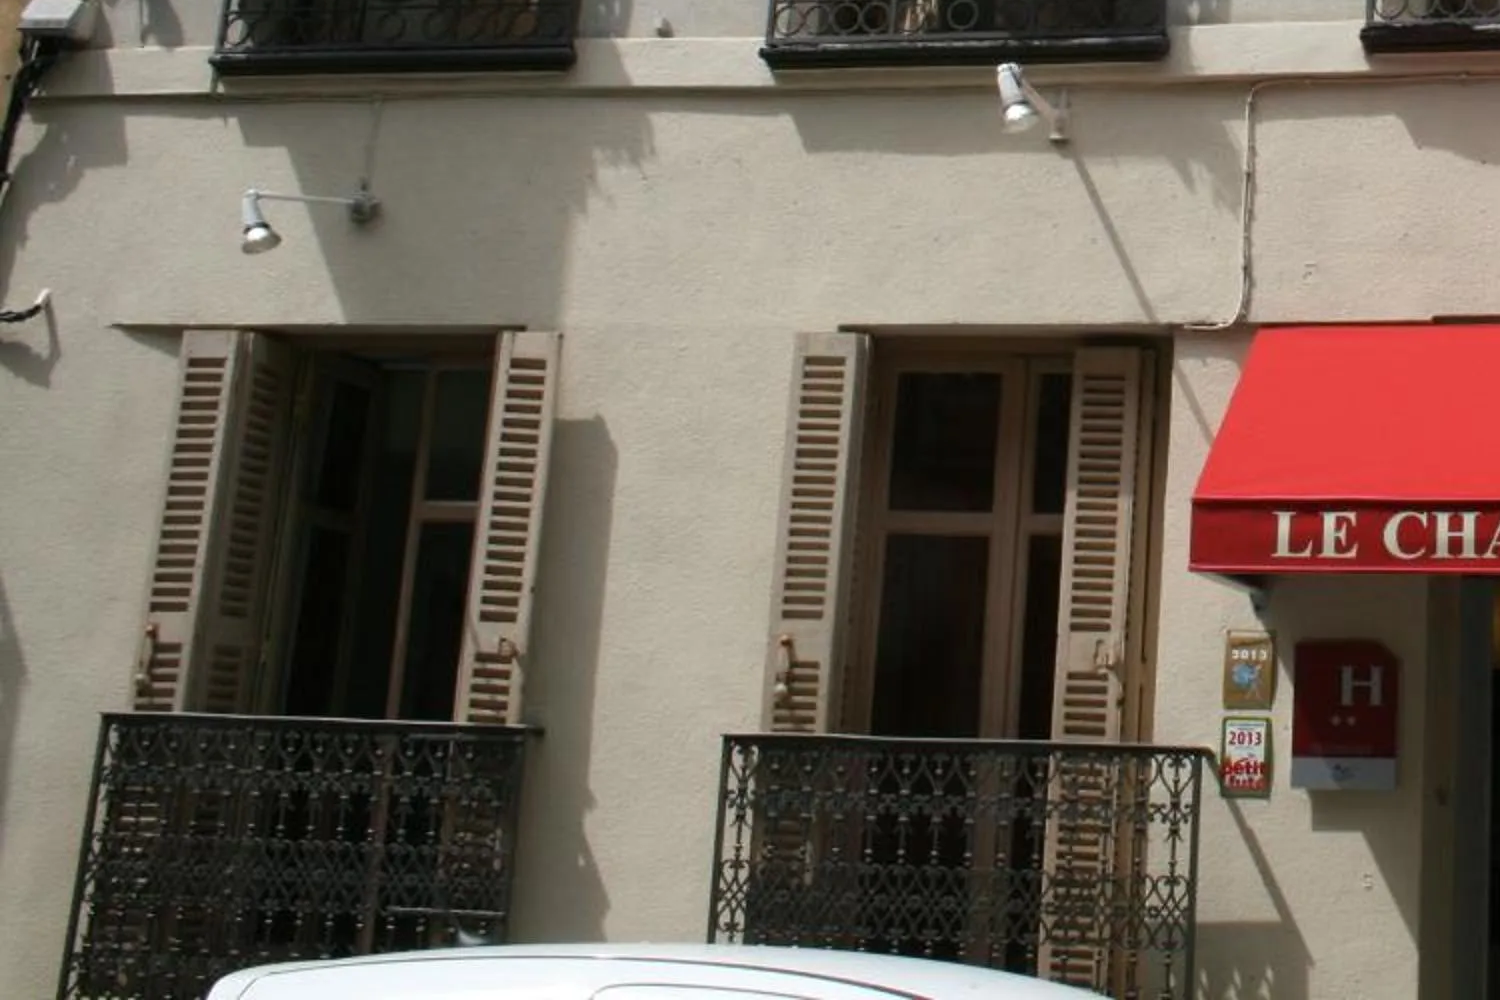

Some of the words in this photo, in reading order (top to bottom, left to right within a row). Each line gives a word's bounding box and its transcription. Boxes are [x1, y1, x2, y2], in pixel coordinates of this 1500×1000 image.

[1271, 510, 1358, 560] LE
[1337, 664, 1385, 706] H
[1228, 730, 1263, 746] 2013
